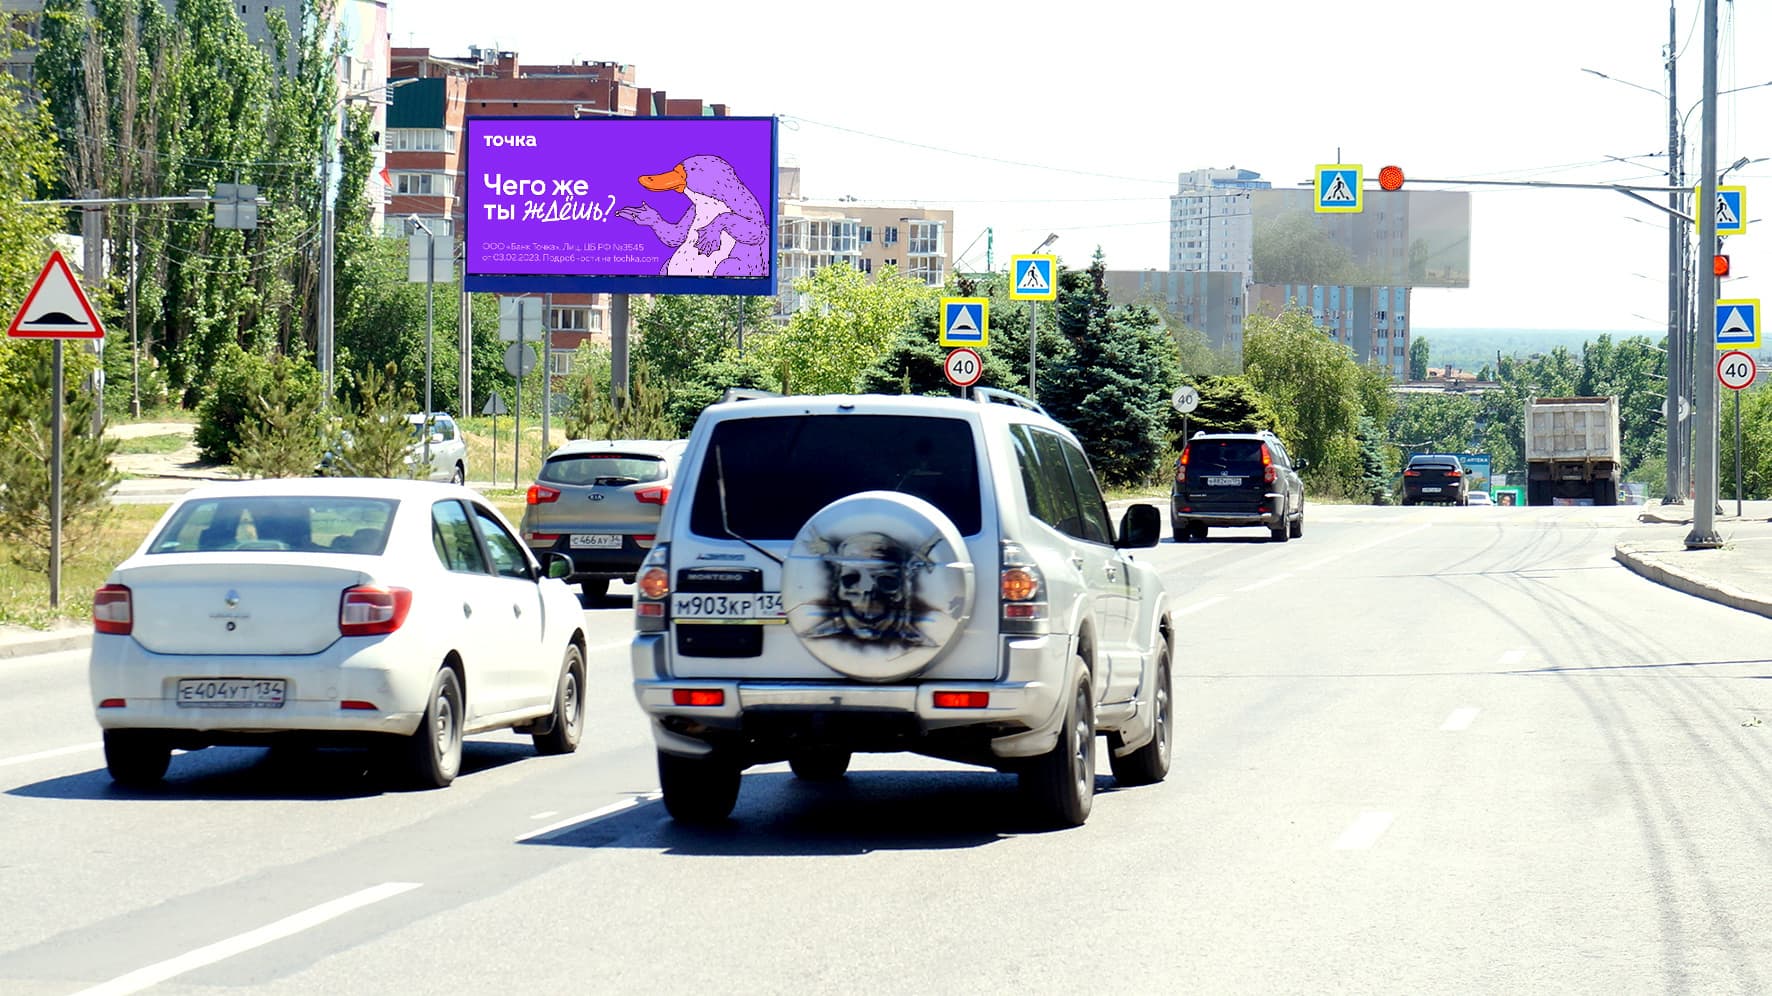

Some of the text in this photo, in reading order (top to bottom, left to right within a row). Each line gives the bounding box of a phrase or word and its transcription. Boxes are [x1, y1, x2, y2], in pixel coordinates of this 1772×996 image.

[483, 135, 537, 147] точка
[483, 173, 589, 196] Чего же
[483, 194, 616, 222] ты ждёшь?
[613, 253, 659, 263] tochka.com
[953, 360, 975, 375] 40
[1725, 363, 1748, 378] 40
[1178, 394, 1193, 405] 40
